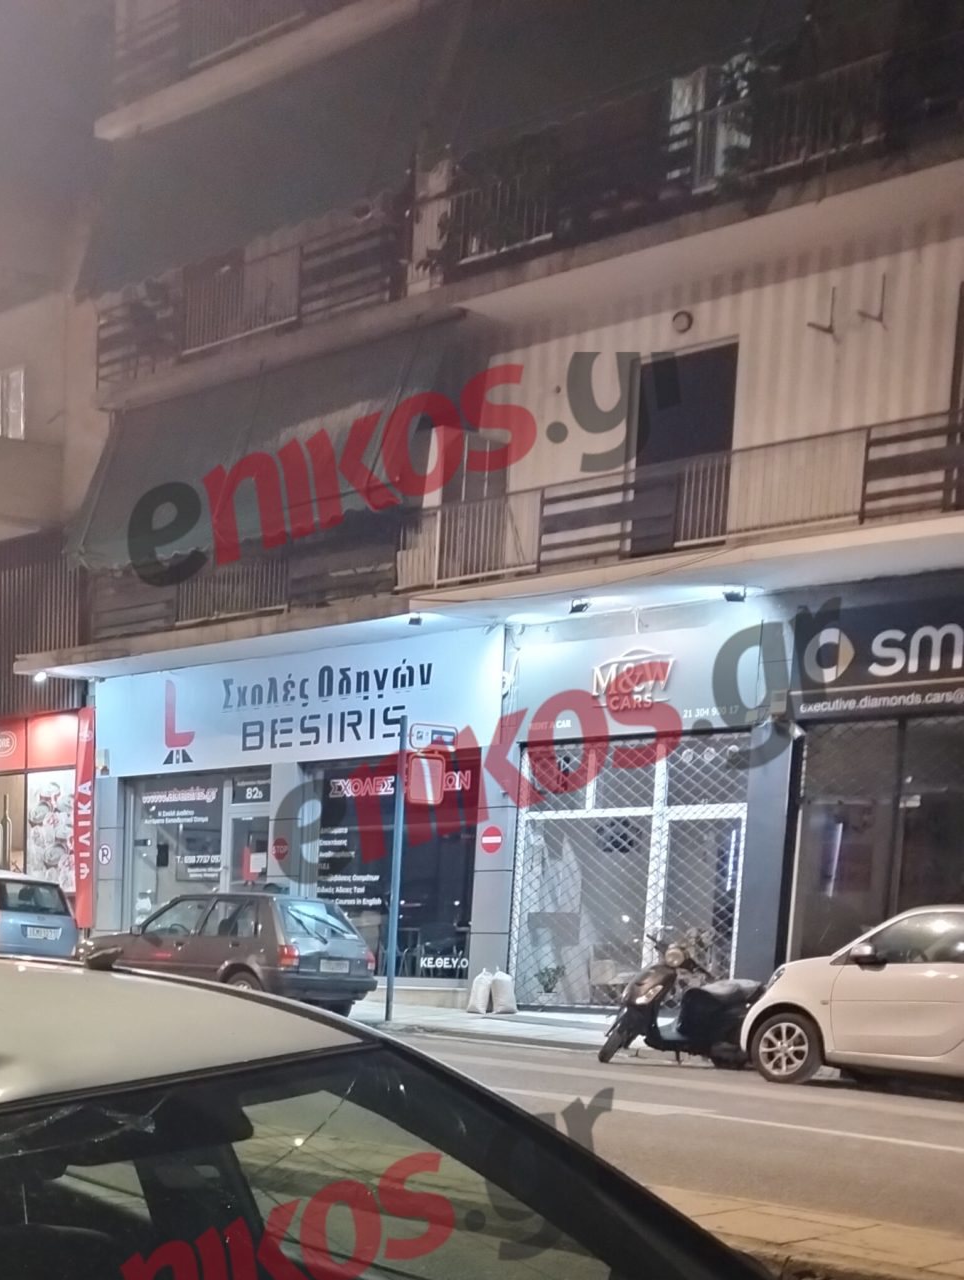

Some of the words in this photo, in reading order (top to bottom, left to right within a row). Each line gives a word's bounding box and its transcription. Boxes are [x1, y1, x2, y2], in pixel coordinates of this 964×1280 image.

[222, 673, 309, 709] Σχολές
[318, 658, 433, 700] Οδηγών
[592, 658, 675, 697] M&W
[609, 694, 652, 711] CARS
[242, 705, 406, 751] BESIRIS
[329, 775, 395, 798] ΣΧΟΛΕΣ
[78, 780, 93, 880] ΨΙΛΙΚΑ
